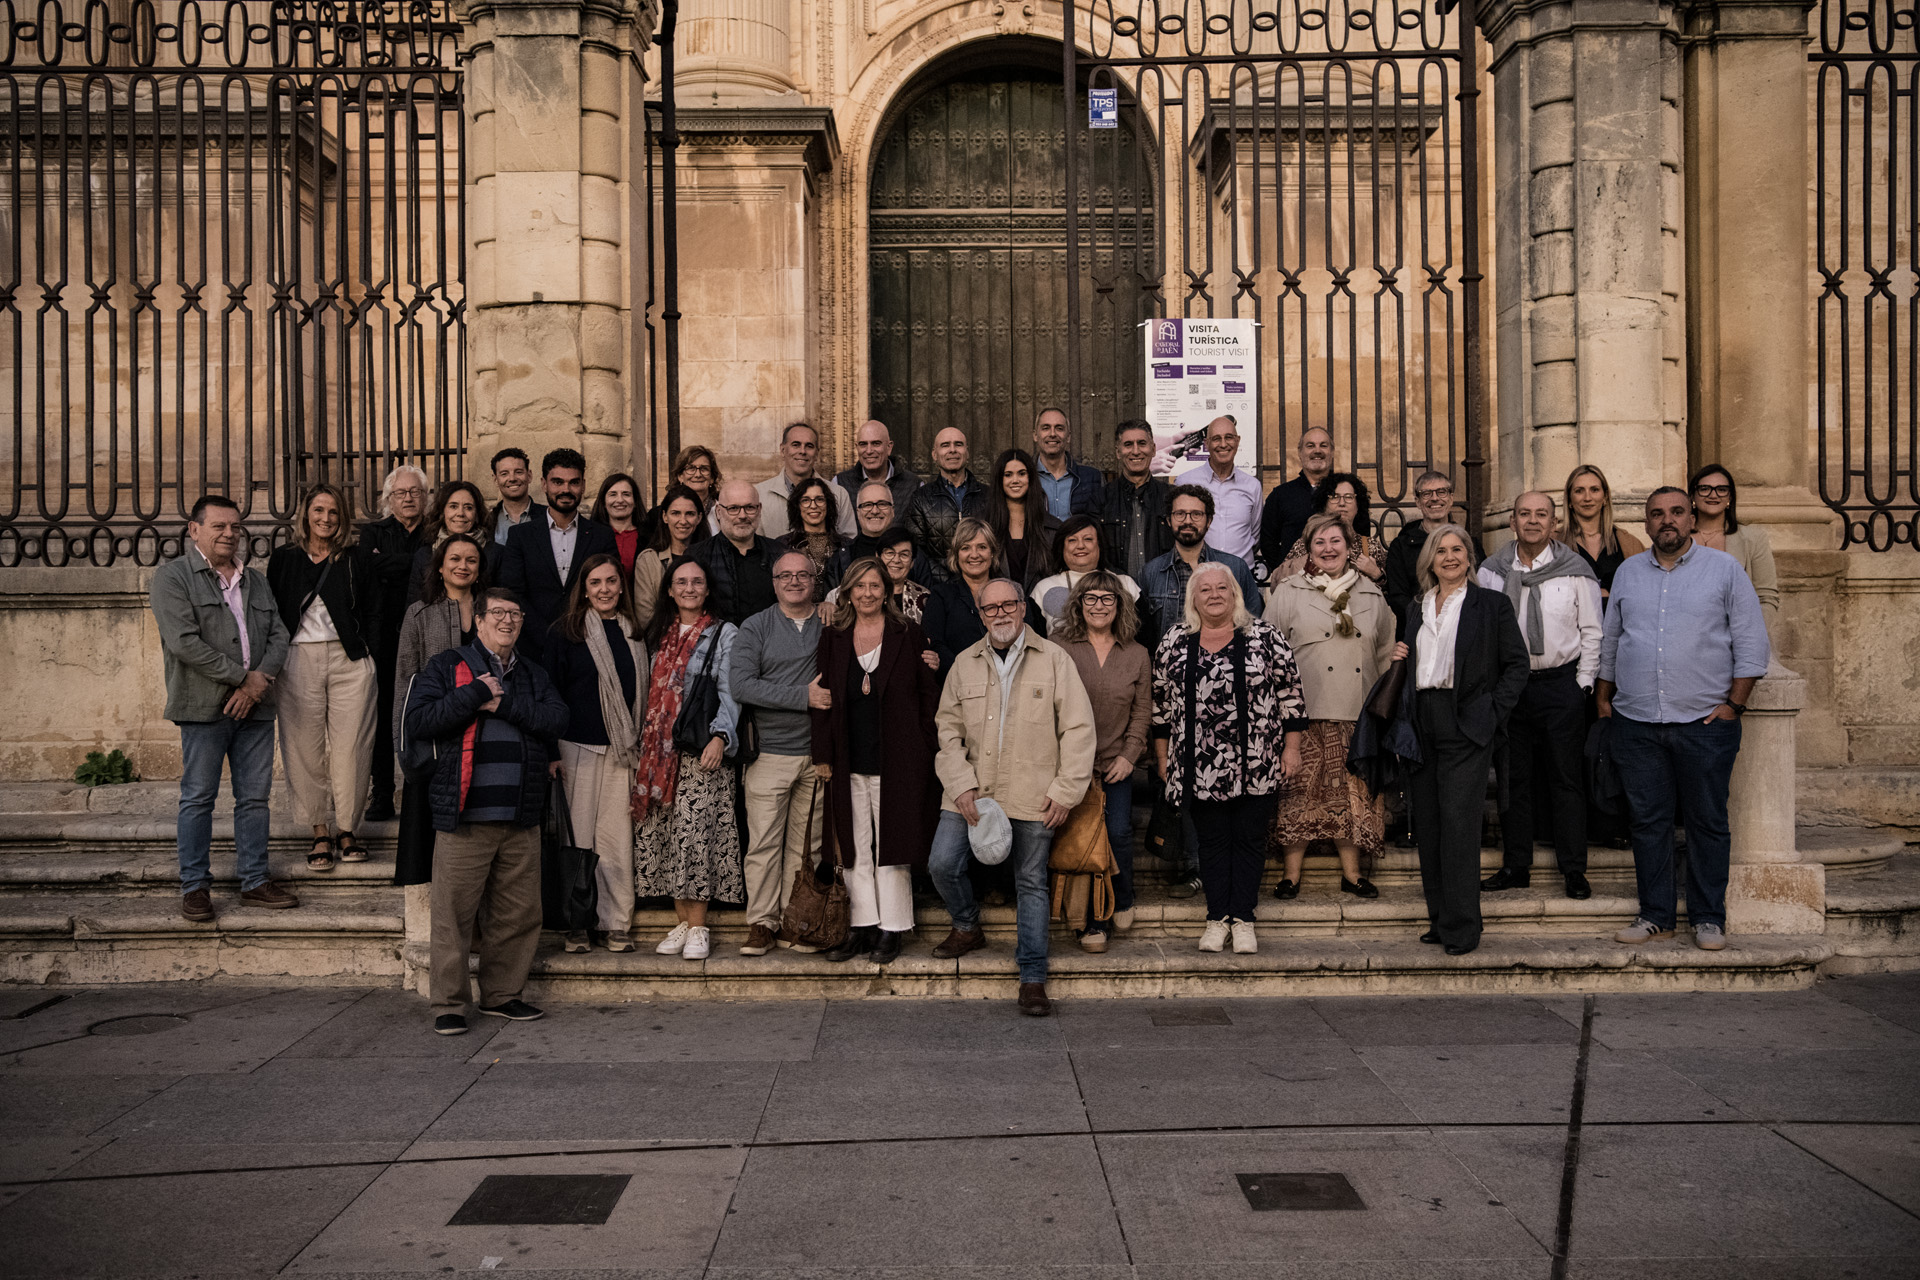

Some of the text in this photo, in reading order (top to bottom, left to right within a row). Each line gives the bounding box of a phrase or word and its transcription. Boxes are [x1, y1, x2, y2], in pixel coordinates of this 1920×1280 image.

[1092, 98, 1114, 107] TPS
[1188, 325, 1220, 333] VISITA
[1188, 335, 1239, 345] TURÍSTICA
[1189, 348, 1249, 356] TOURIST VISIT
